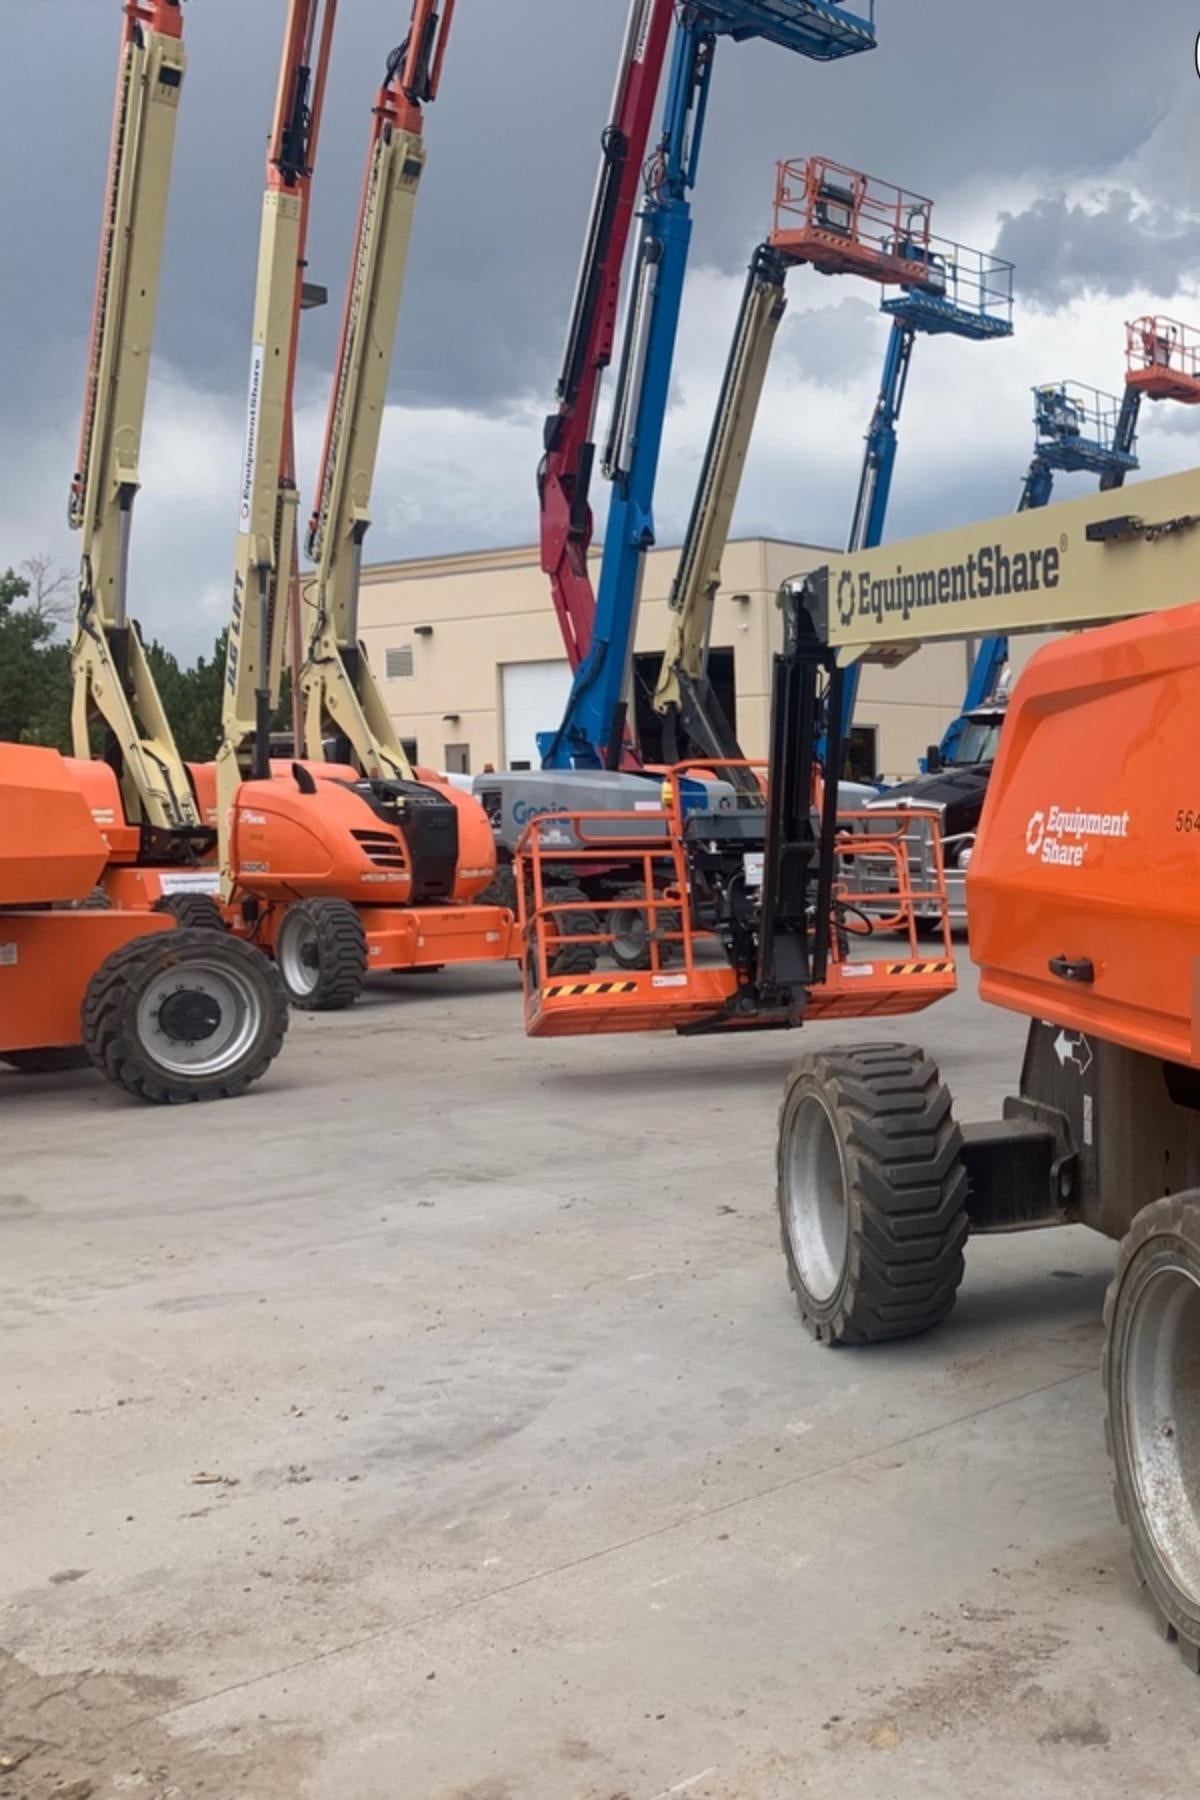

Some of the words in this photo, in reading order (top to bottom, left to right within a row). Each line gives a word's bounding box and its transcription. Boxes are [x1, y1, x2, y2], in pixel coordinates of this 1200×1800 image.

[231, 569, 244, 637] LIFT
[227, 640, 239, 697] JLG
[1047, 806, 1129, 839] Equipment
[1041, 836, 1083, 866] Share
